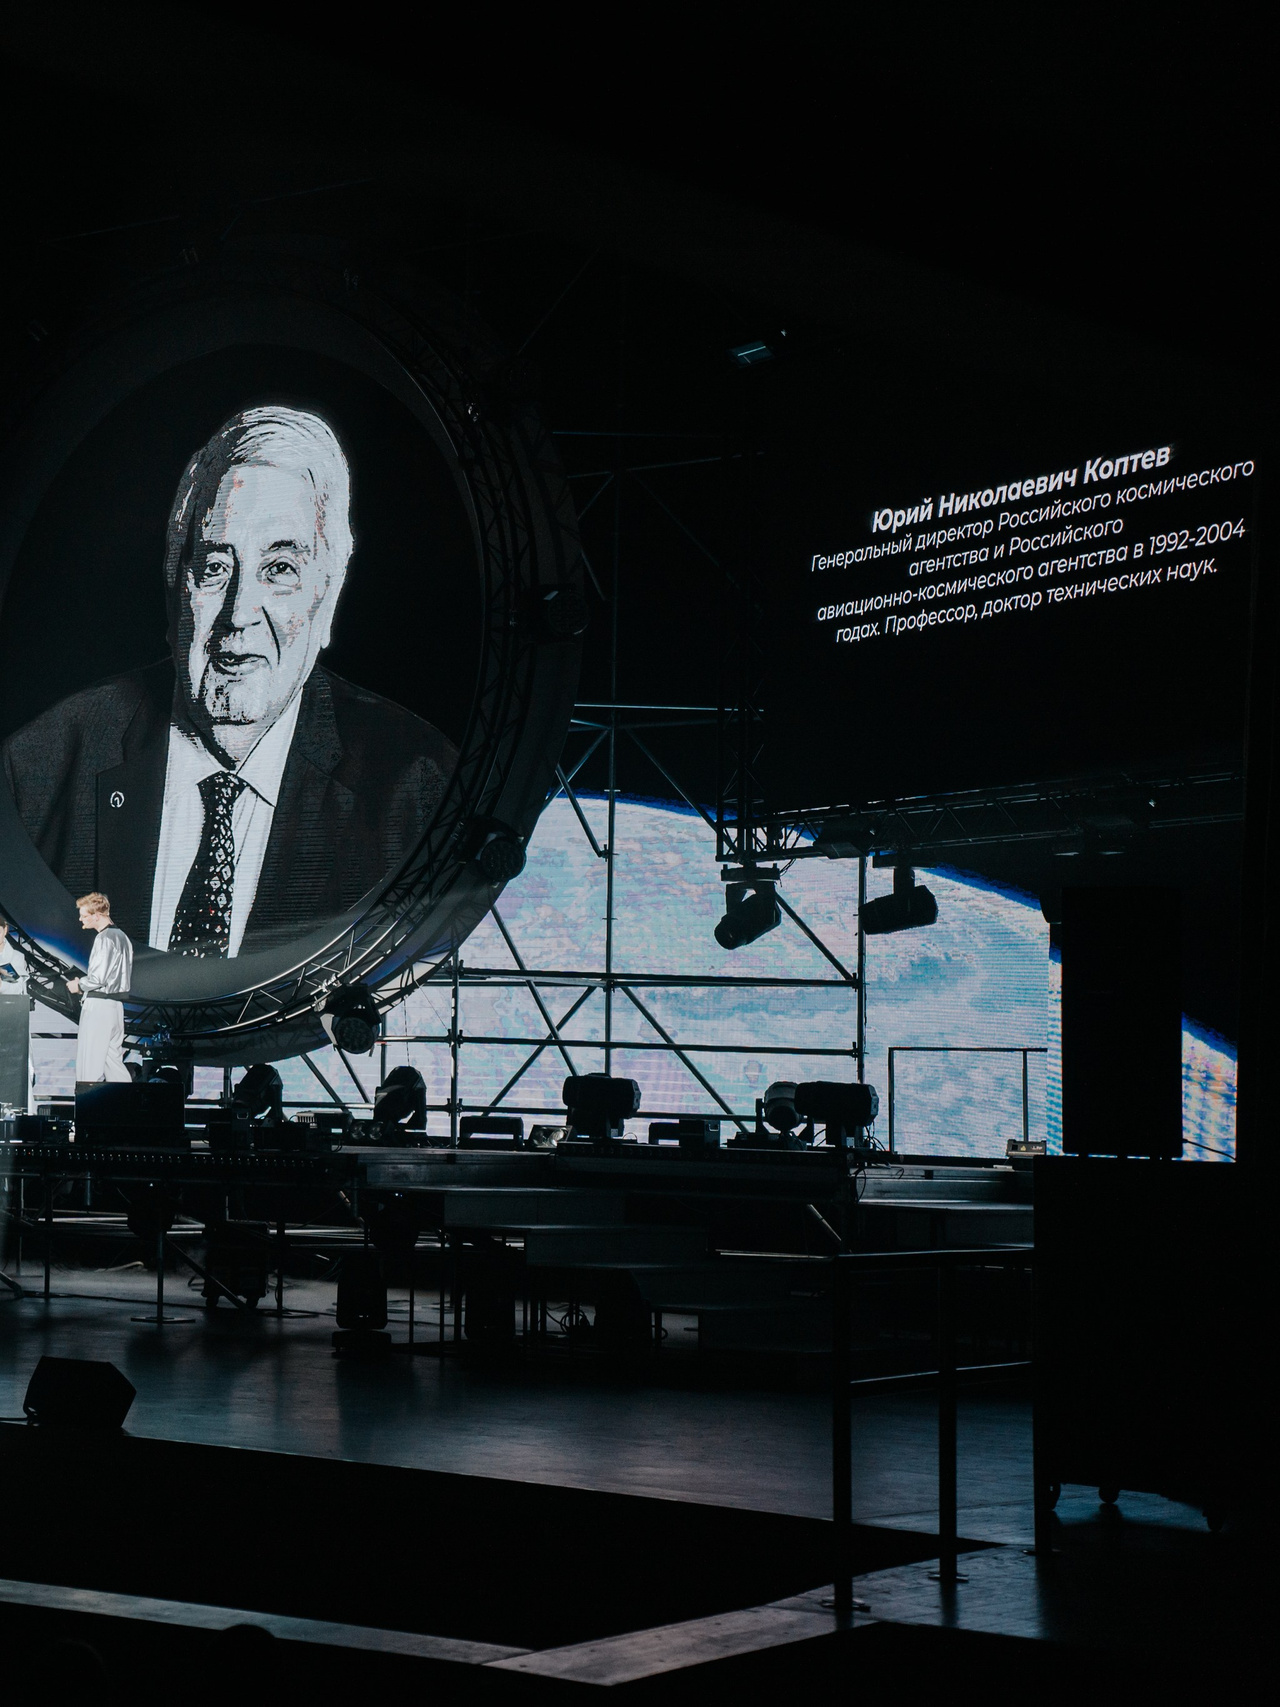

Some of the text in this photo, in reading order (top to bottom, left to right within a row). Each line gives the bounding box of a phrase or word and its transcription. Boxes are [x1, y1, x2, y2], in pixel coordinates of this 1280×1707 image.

[811, 460, 1255, 573] Генеральный директор Российского космического
[872, 446, 1171, 534] Юрий Николаевич Коптев
[817, 517, 1246, 622] авиационно-космического агентства в 1992-2004
[908, 518, 1124, 577] агентства и Российского
[836, 557, 1218, 643] годах. Профессор, доктор технических наук.
